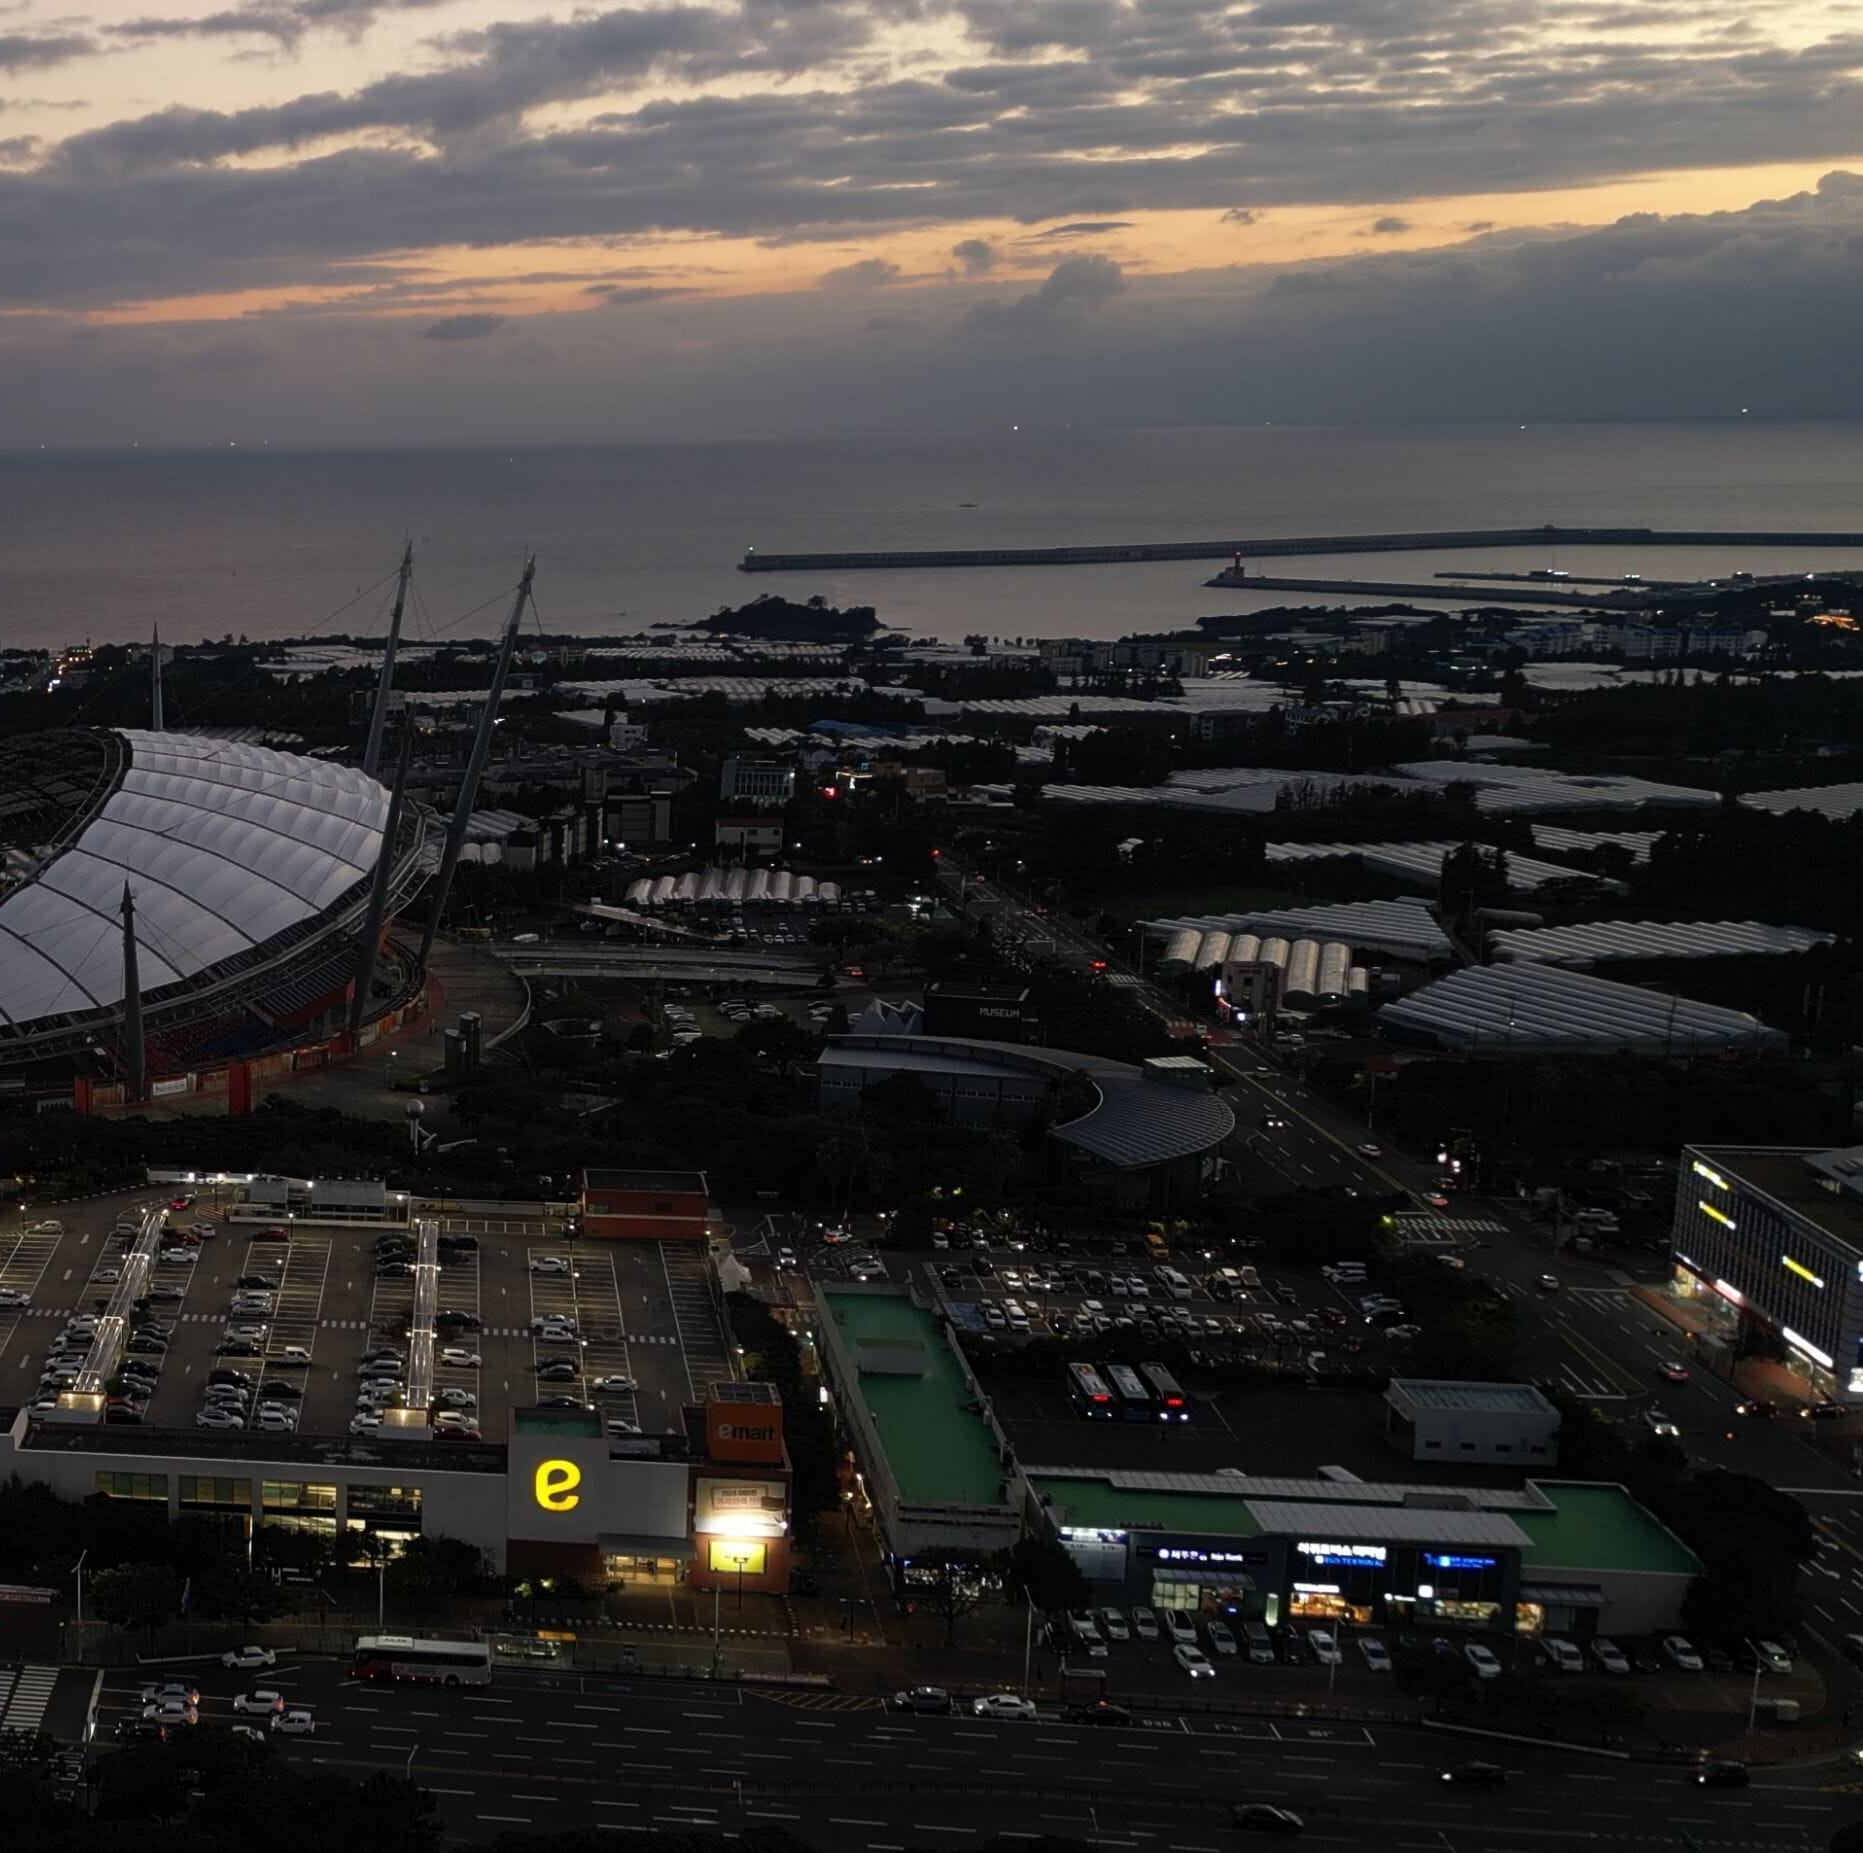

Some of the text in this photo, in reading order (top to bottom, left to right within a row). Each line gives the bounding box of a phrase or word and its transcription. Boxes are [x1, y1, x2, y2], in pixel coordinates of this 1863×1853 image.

[978, 1007, 1020, 1018] MUSEUM
[719, 1424, 776, 1441] emart
[534, 1459, 582, 1512] e
